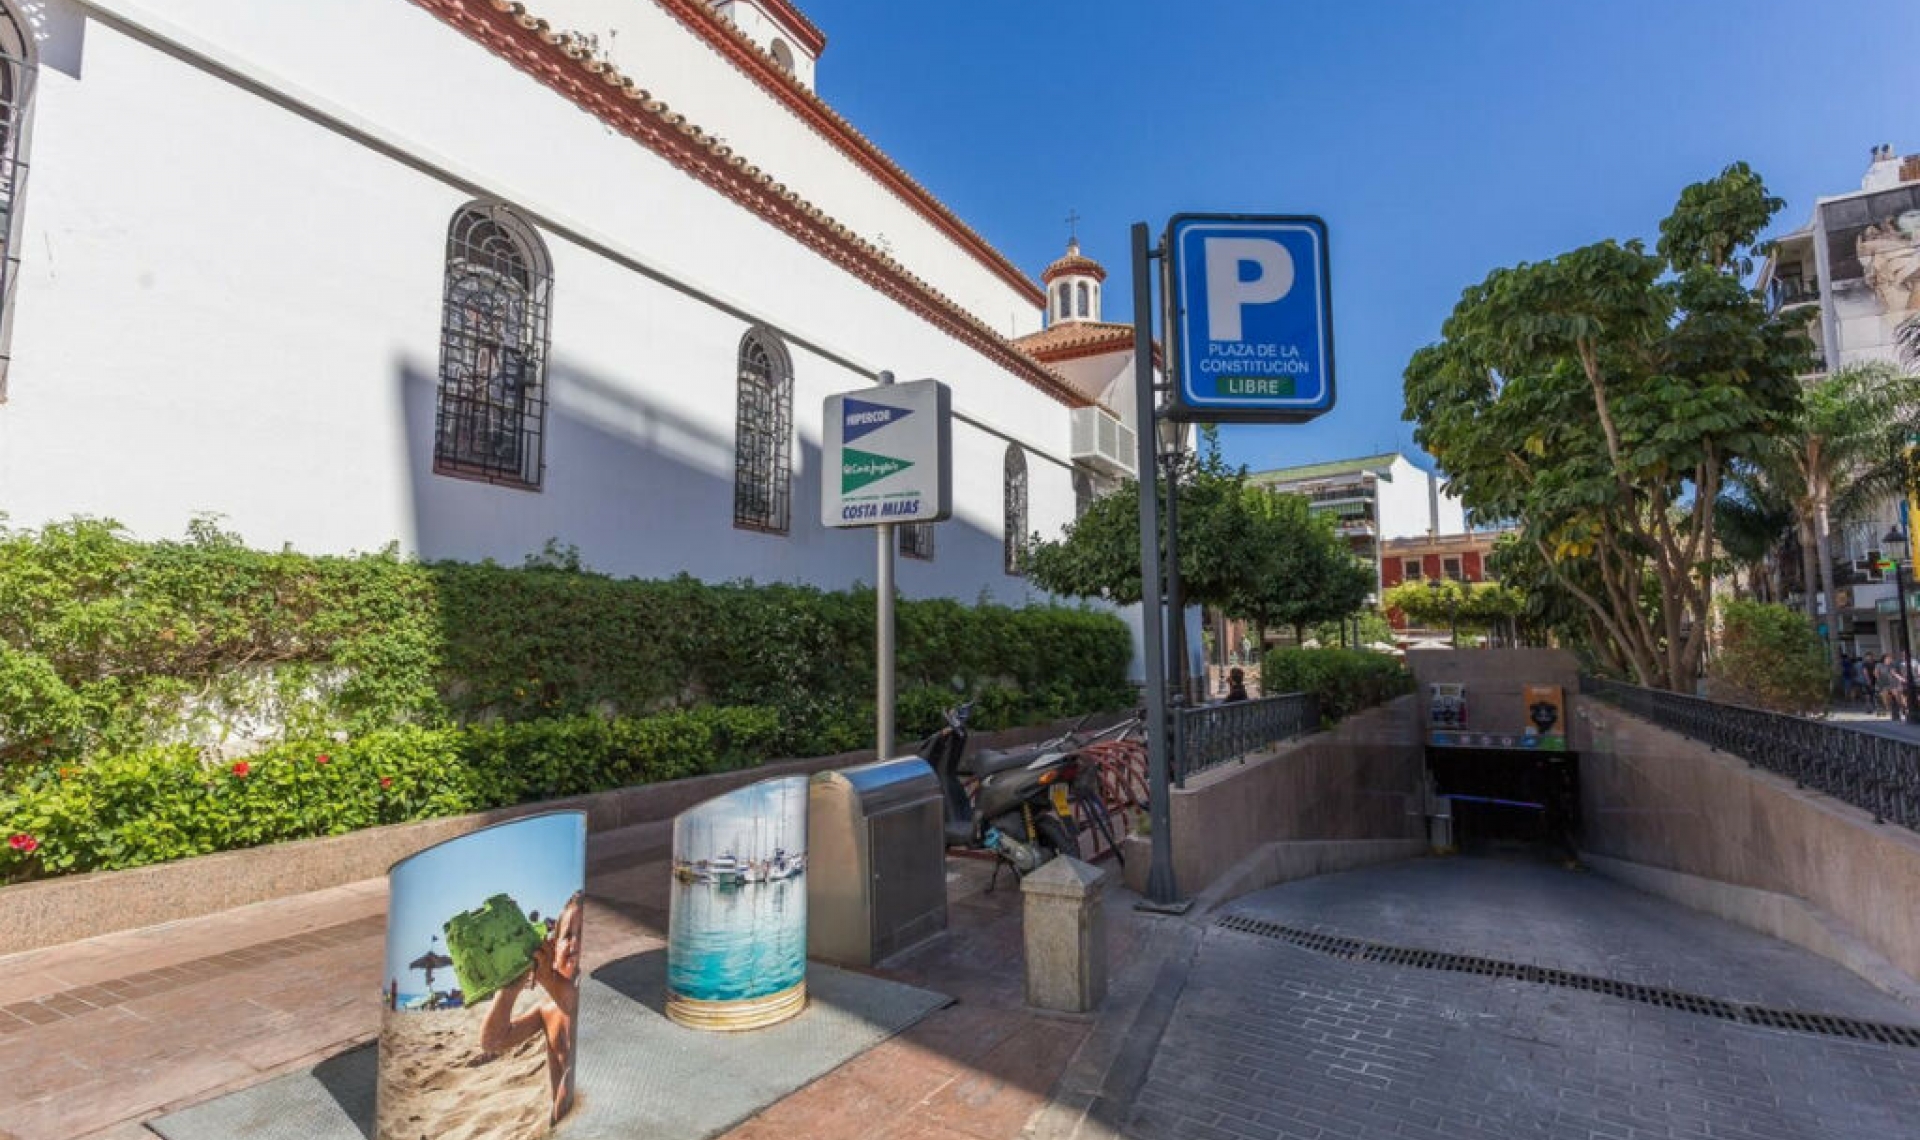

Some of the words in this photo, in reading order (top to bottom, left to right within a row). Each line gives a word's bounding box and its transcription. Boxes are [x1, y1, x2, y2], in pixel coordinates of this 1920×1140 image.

[1204, 236, 1295, 341] P
[1208, 343, 1255, 356] PLAZA
[1257, 343, 1277, 357] DE
[1281, 344, 1299, 358] LA
[1200, 358, 1309, 373] CONSTITUCIÓN
[1229, 378, 1279, 394] LIBRE
[842, 503, 877, 519] COSTA
[881, 499, 920, 516] MIJAS
